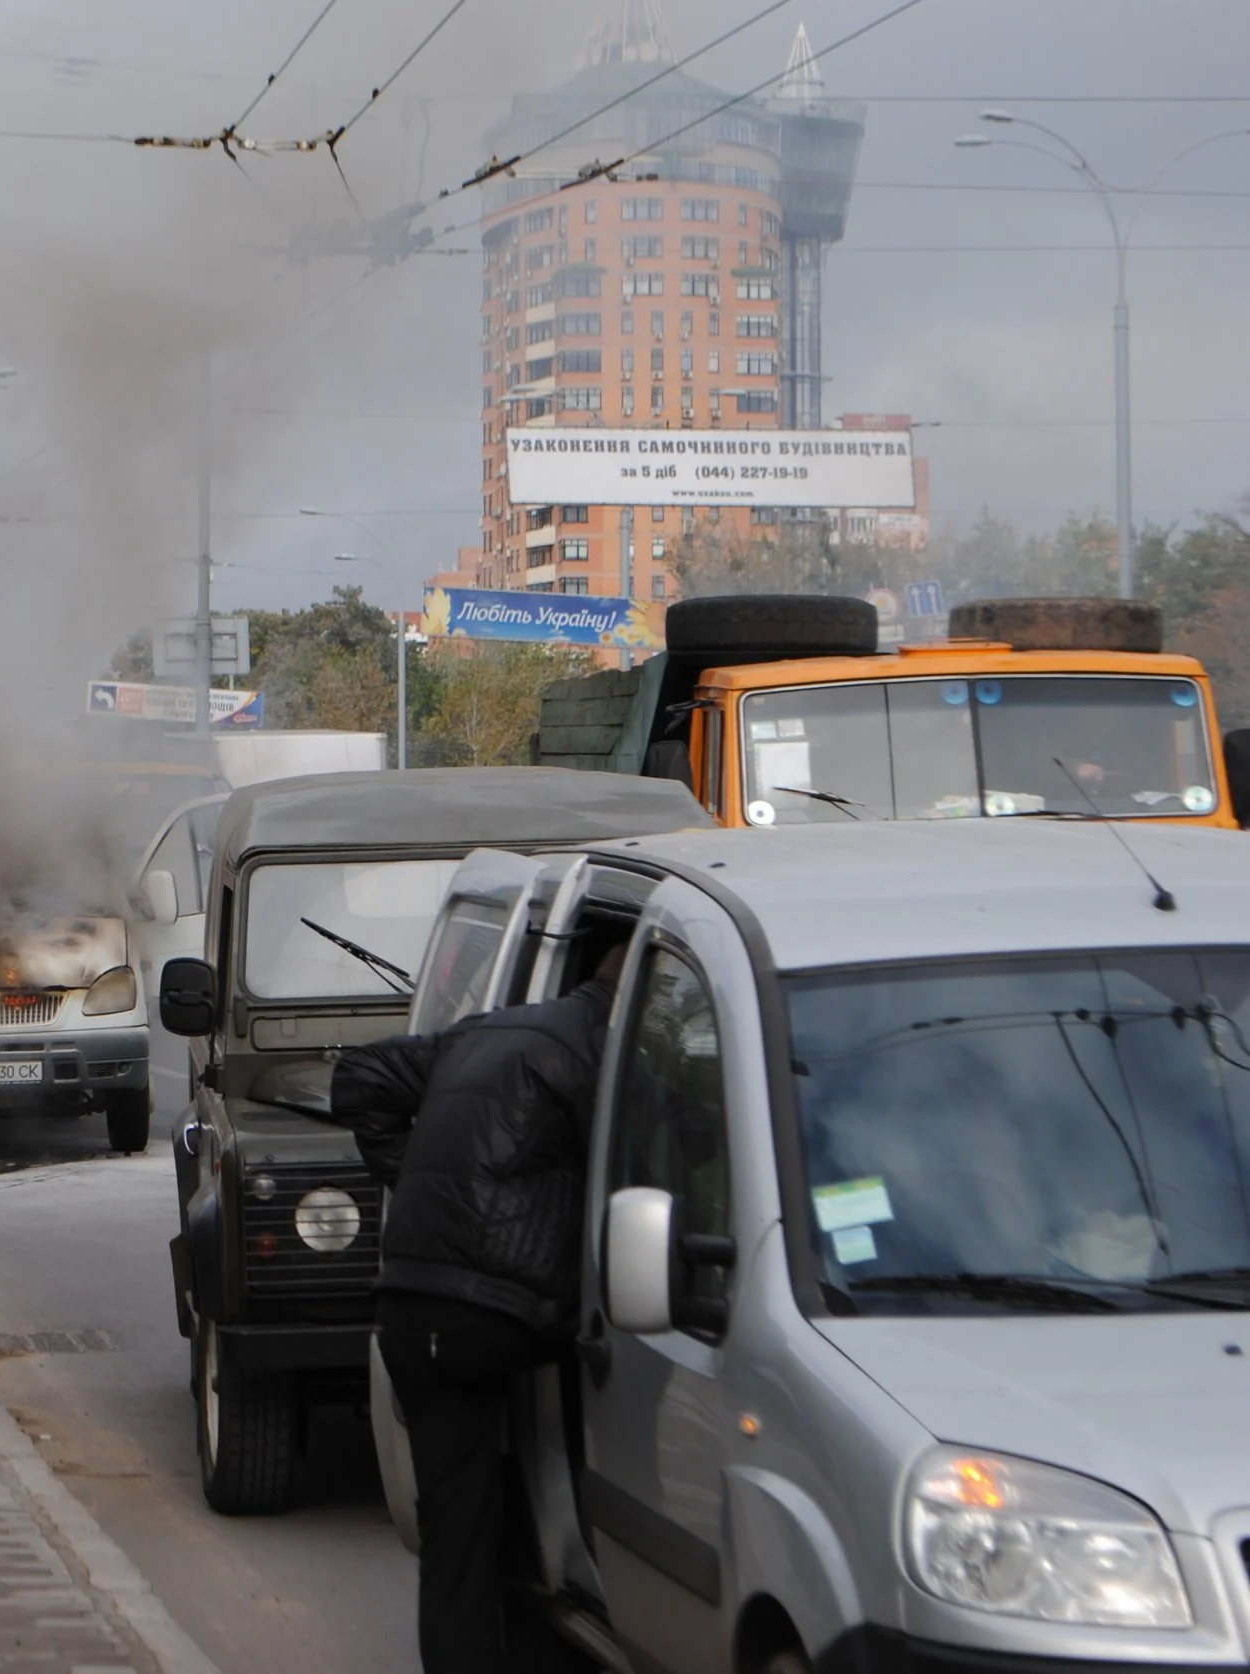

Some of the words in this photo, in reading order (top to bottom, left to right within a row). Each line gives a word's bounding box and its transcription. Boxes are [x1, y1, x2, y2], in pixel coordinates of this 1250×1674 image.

[510, 439, 631, 453] УЗАКОНЕННЯ
[638, 440, 771, 456] САМОЧИННОГО
[779, 442, 907, 457] БУДІВНИЦТВА
[621, 467, 637, 478] за
[642, 466, 650, 478] 5
[655, 465, 677, 480] діб
[695, 467, 735, 480] (044)
[740, 467, 808, 479] 227-19-19
[457, 602, 533, 624] Любіть
[535, 607, 617, 632] Україну!
[18, 1064, 39, 1078] CK
